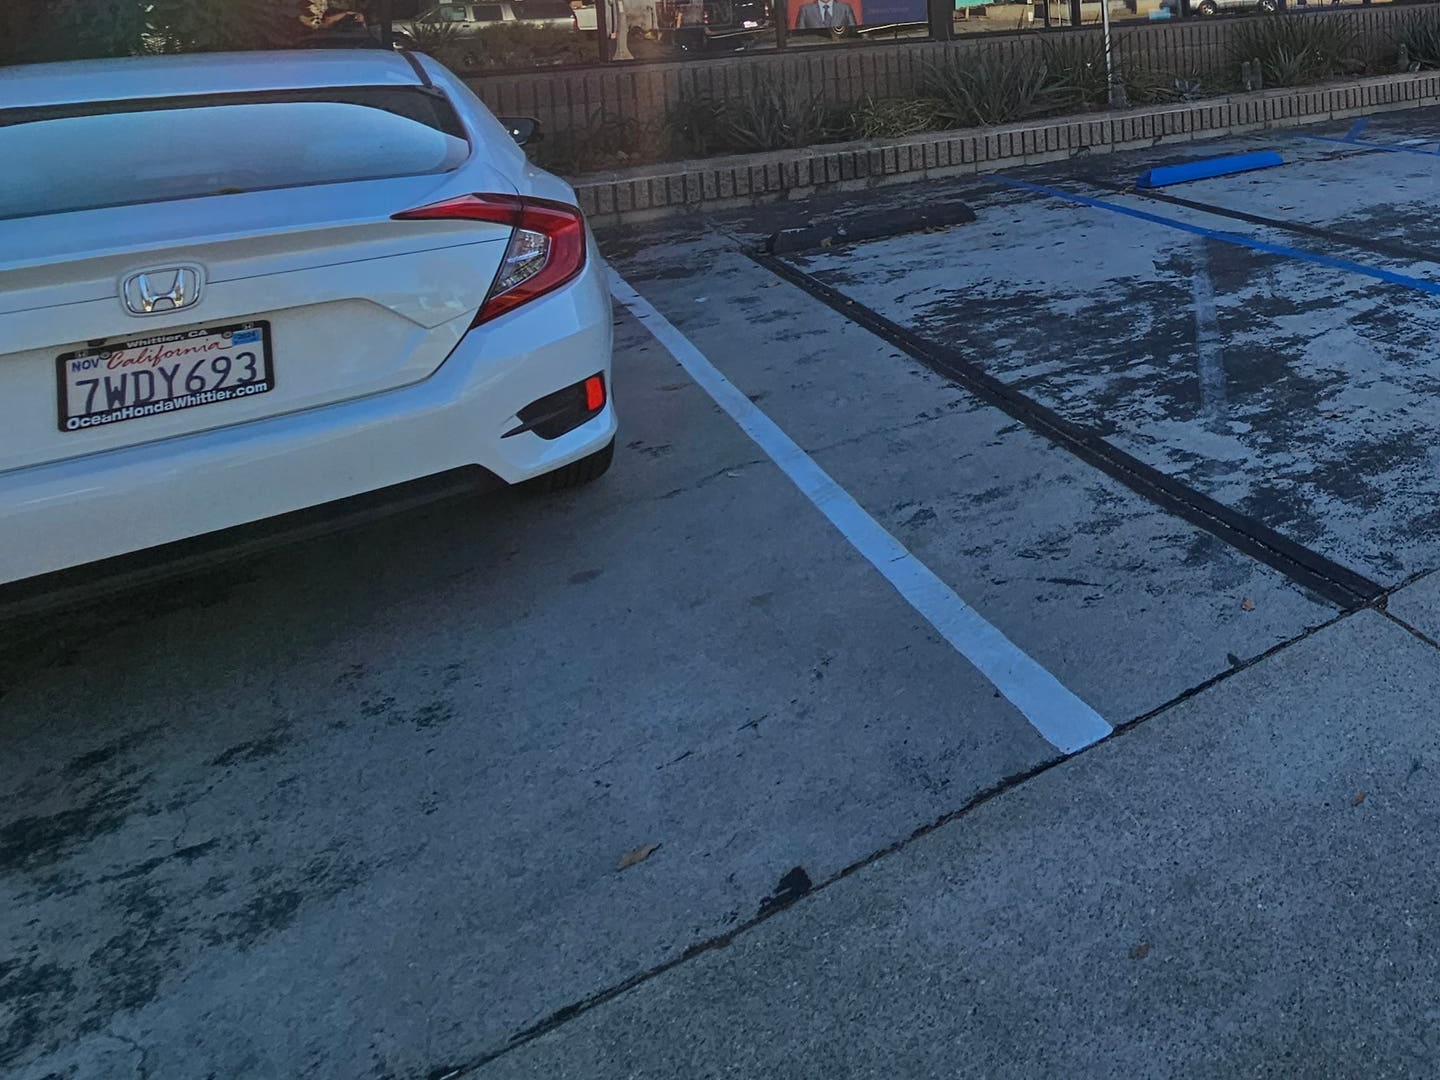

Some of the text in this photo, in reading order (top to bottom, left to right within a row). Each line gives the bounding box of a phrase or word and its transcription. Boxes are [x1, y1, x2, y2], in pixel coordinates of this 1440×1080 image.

[127, 329, 208, 349] Whittier, CA
[72, 358, 99, 372] NOV
[107, 340, 232, 370] California
[75, 351, 258, 414] 7WDY693
[67, 382, 267, 430] OceanHondaWhittier.com
